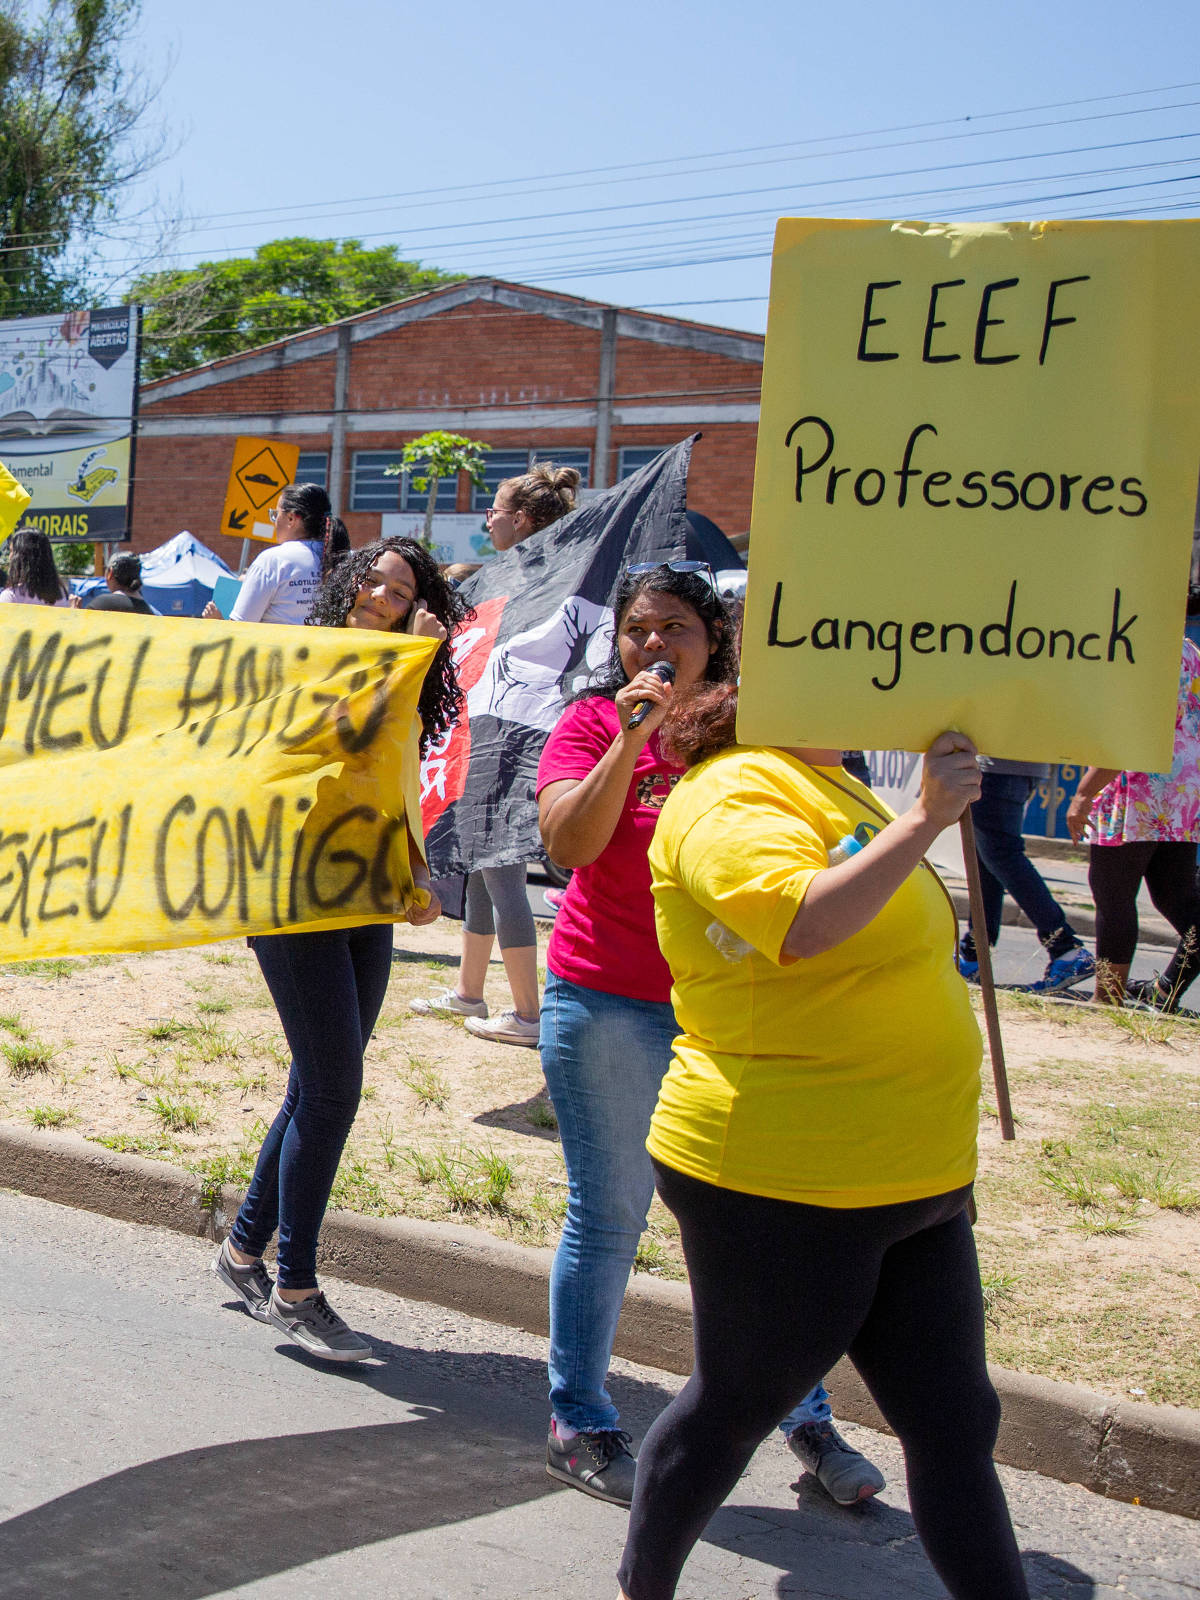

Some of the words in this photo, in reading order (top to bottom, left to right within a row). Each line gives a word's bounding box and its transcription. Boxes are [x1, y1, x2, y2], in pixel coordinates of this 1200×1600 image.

[857, 275, 1090, 366] EEEF
[785, 416, 1148, 517] Professores
[25, 514, 89, 536] MORAIS
[767, 580, 1138, 690] Langendonck
